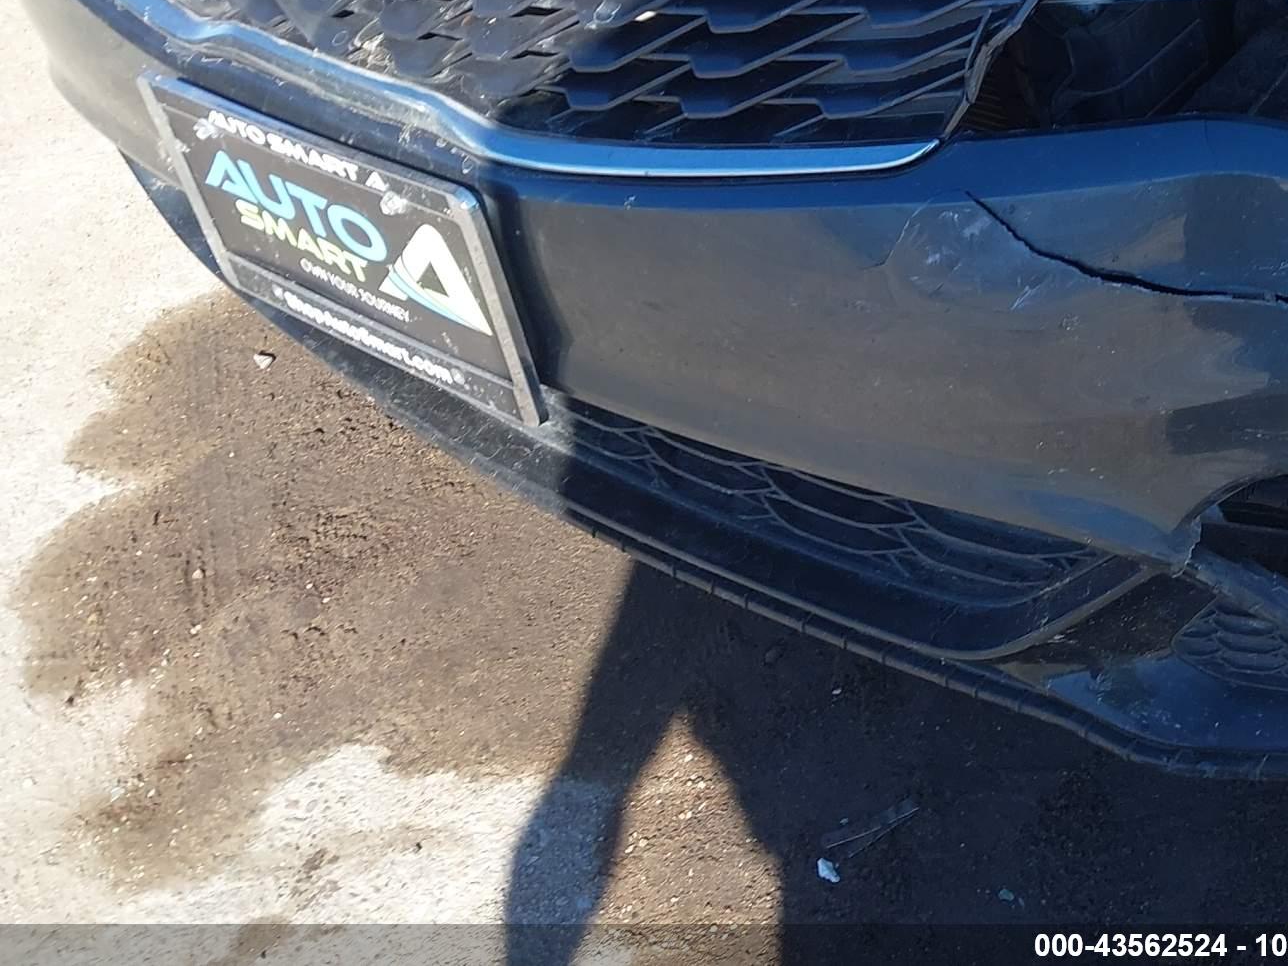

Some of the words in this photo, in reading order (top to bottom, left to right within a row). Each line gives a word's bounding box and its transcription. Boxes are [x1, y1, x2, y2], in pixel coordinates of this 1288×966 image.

[207, 110, 266, 145] AUTO
[266, 135, 359, 181] SMART
[205, 149, 387, 265] AUTO
[235, 200, 368, 283] SMART
